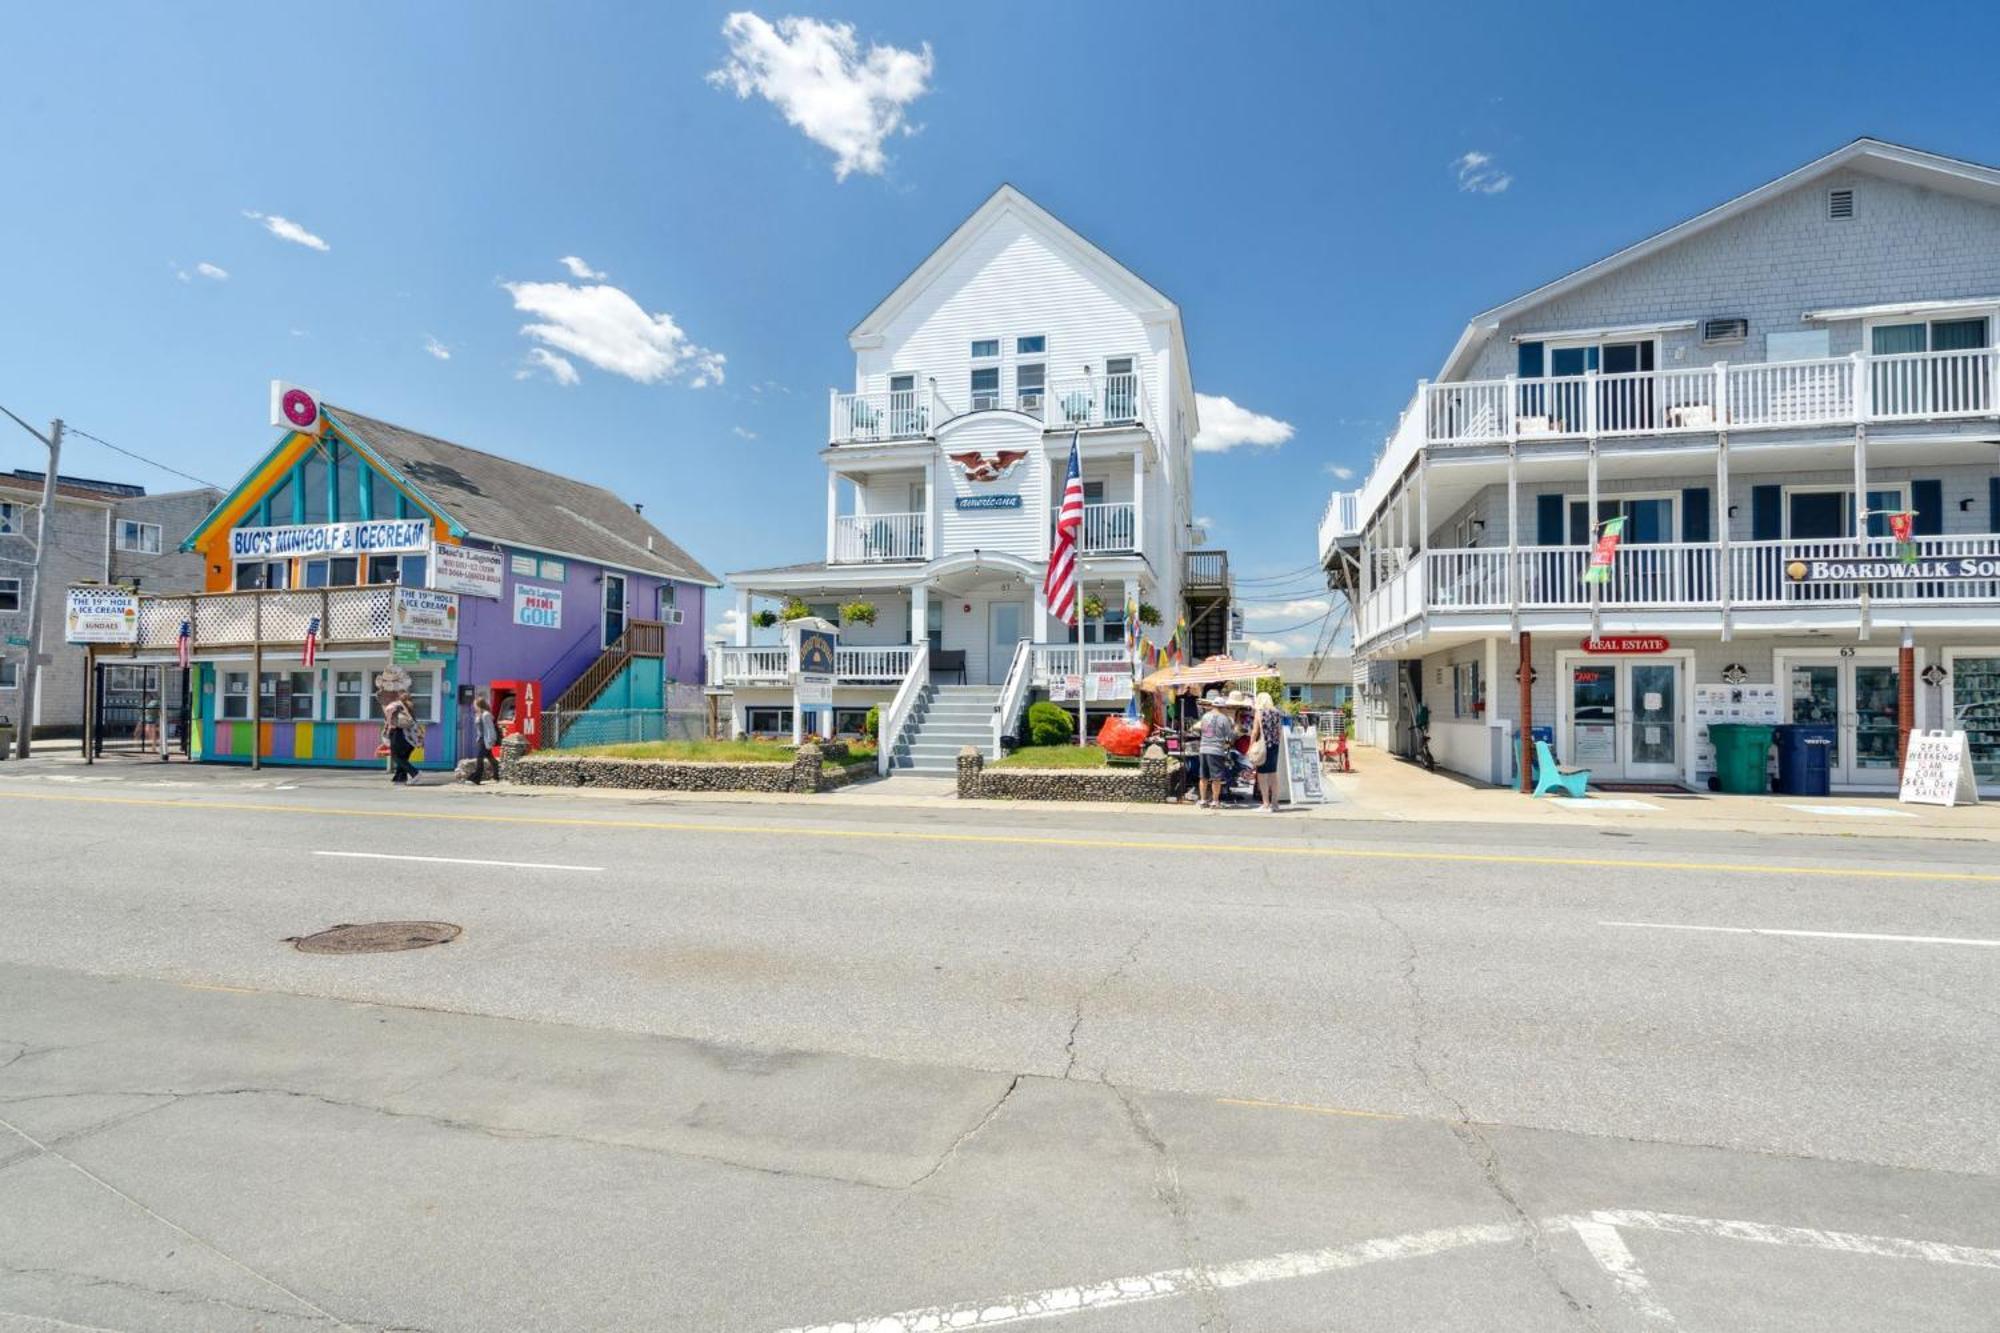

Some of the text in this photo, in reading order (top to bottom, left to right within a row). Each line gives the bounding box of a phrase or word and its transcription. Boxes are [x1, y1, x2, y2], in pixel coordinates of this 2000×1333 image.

[960, 497, 1017, 507] americana
[235, 523, 424, 554] BUC'S MINIGOLF & ICECREAM
[1811, 561, 1950, 579] BOARDWALK
[400, 589, 415, 598] THE
[434, 593, 453, 603] HOLE
[73, 598, 89, 606] THE
[110, 598, 132, 606] HOLE
[406, 600, 448, 610] ICE CREAM
[526, 597, 553, 609] MINI
[520, 607, 558, 626] GOLF
[1588, 640, 1664, 650] REAL ESTATE
[523, 682, 534, 735] ATM
[1920, 743, 1949, 751] OPEN
[1909, 752, 1960, 761] WEEKENDS
[1915, 770, 1944, 778] COME
[1934, 779, 1954, 788] OUR
